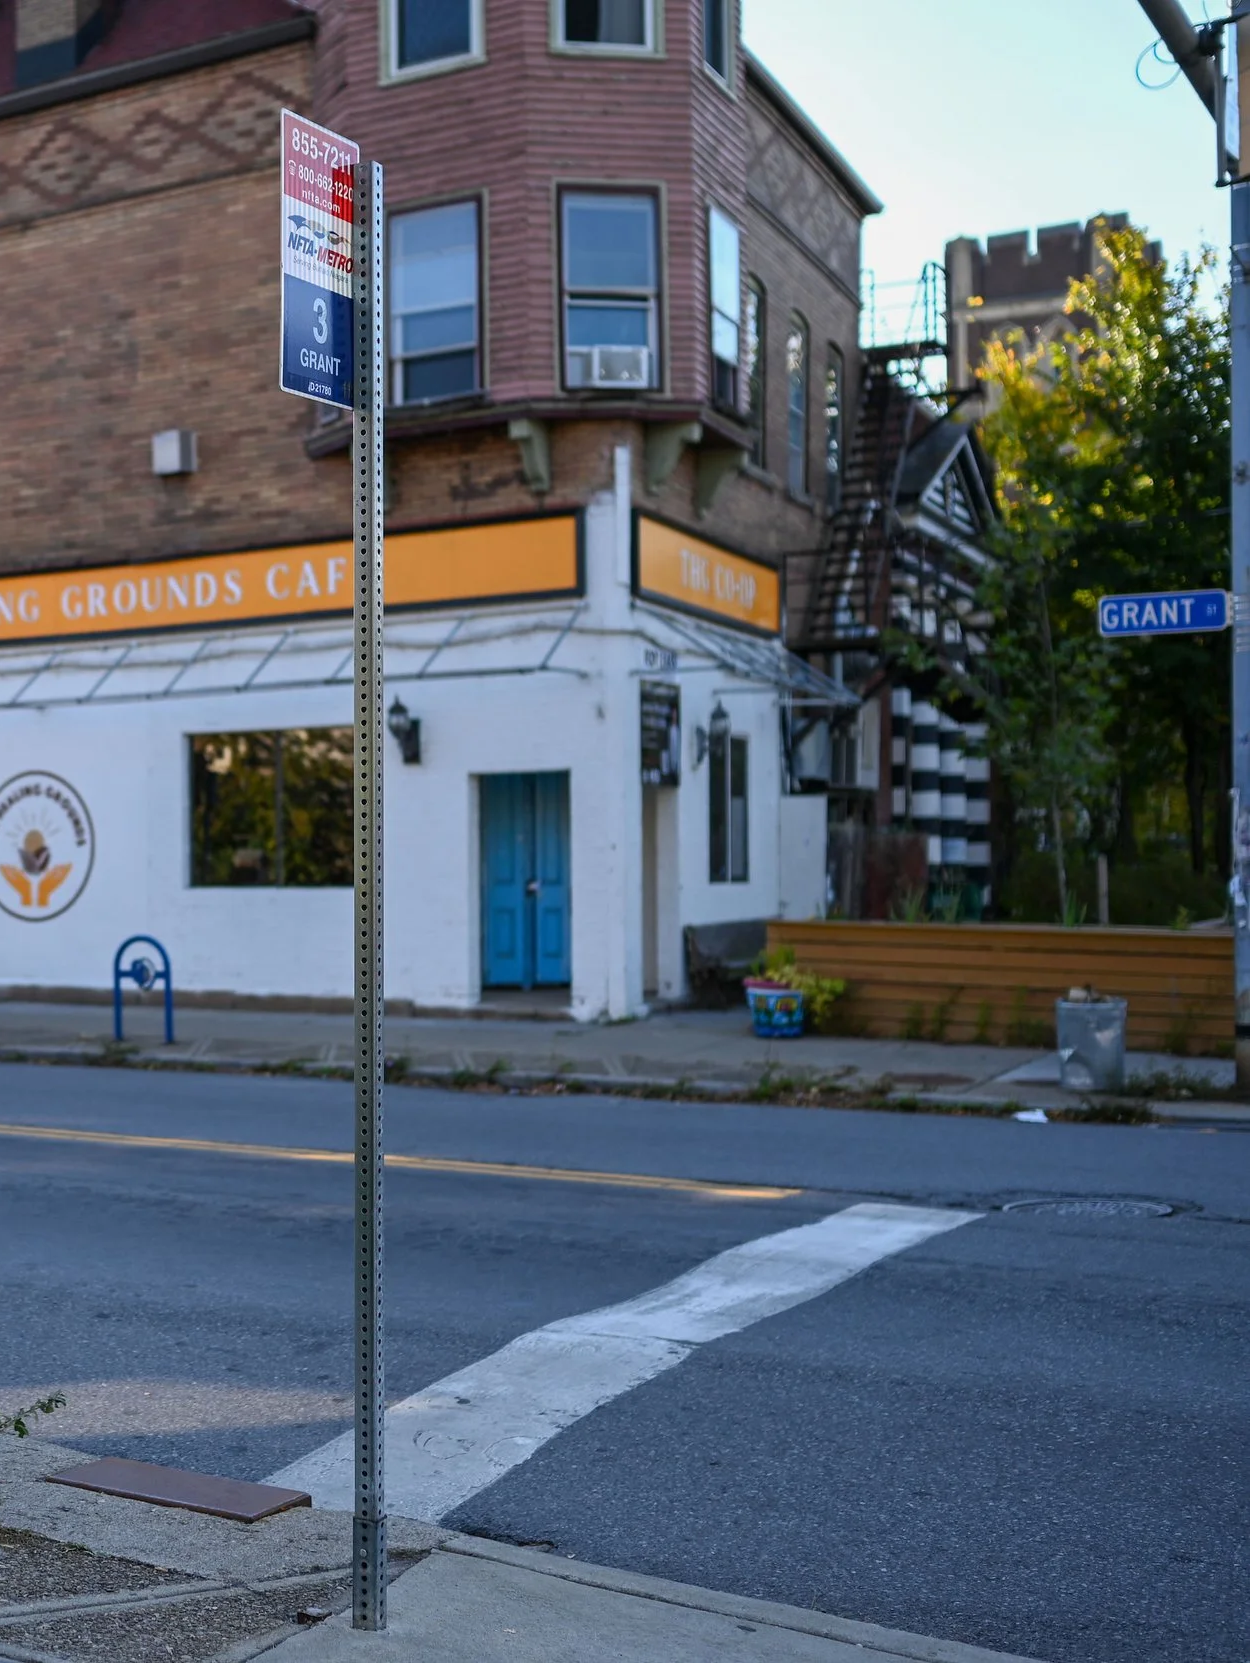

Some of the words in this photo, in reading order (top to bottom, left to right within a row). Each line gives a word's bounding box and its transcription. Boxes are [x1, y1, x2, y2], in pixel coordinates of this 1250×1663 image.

[291, 127, 351, 176] 855-7211
[298, 164, 354, 202] 800-662-1220
[302, 189, 341, 214] nfta.com
[313, 297, 328, 345] 3
[300, 347, 341, 377] GRANT
[61, 568, 244, 620] GROUNDS
[265, 555, 348, 601] CAF
[1103, 598, 1195, 630] GRANT
